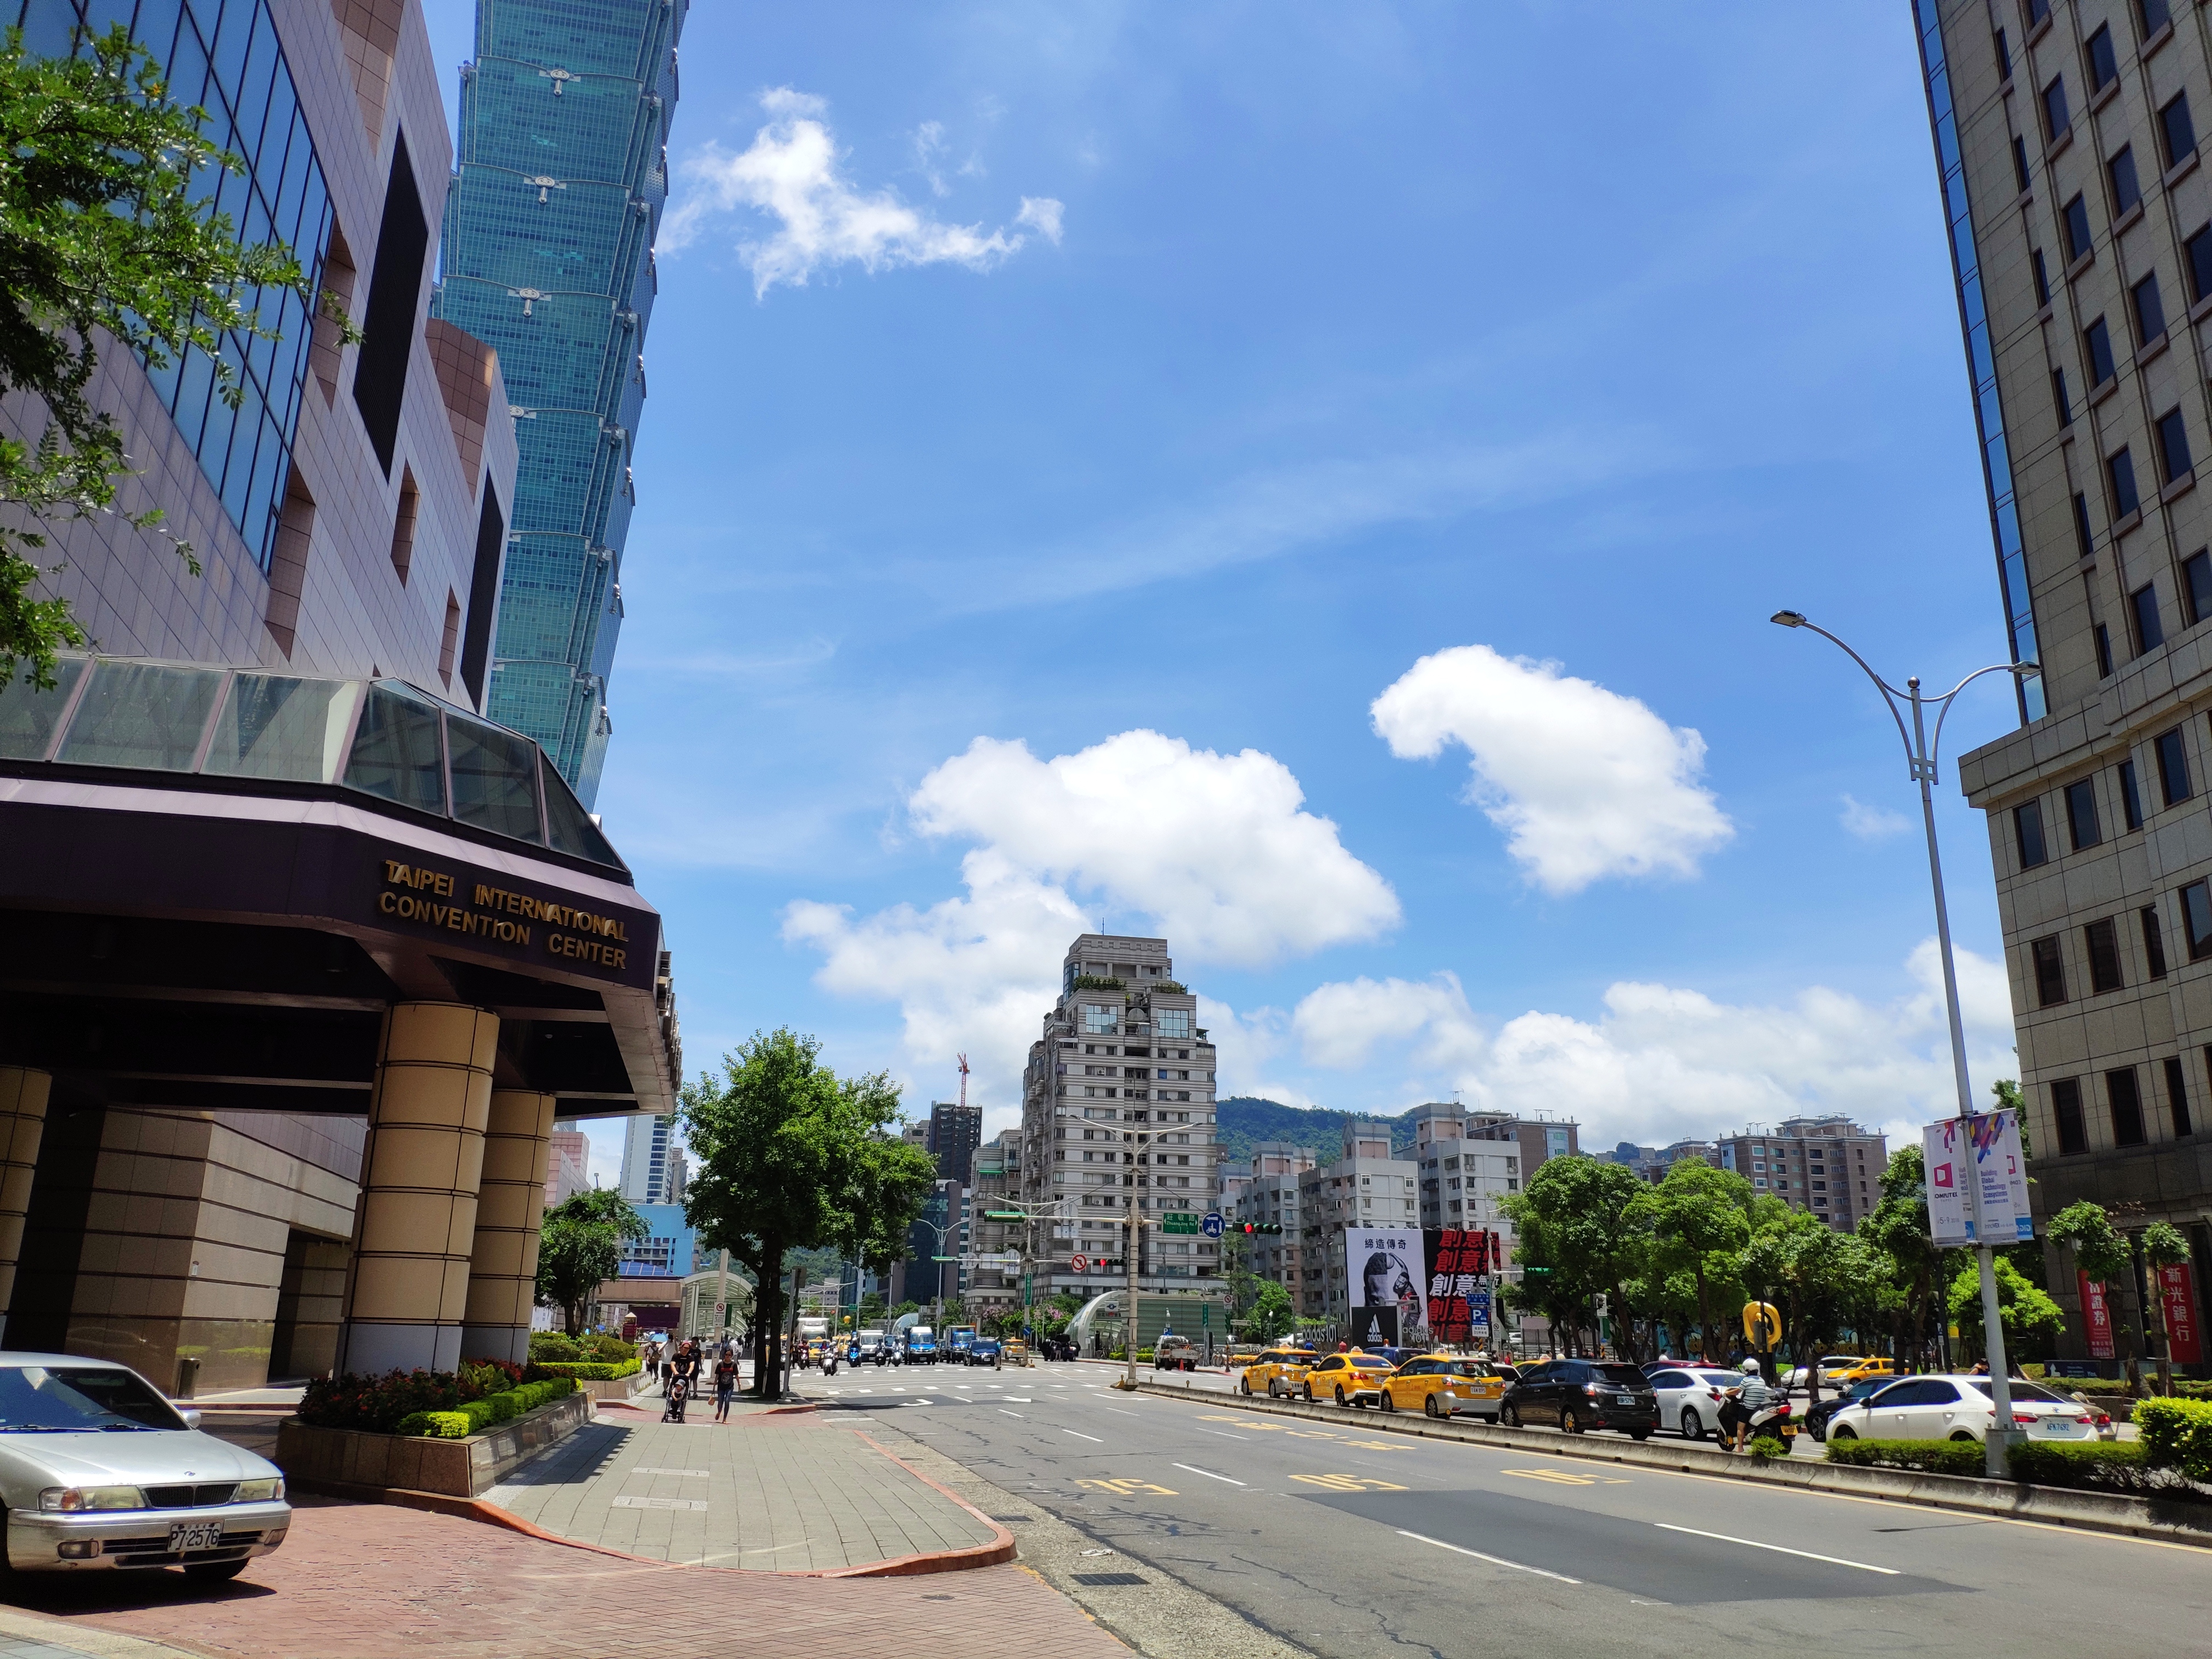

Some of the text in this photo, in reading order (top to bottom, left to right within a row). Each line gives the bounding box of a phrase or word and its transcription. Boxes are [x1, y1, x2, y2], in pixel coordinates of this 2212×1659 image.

[382, 860, 629, 942] TAIPEI INTERNATIONAL
[379, 891, 627, 969] CONVENTION CENTER
[1983, 1190, 2008, 1199] Ecosystems
[1166, 1213, 1195, 1221] 莊敬路
[1364, 1238, 1406, 1249] 締造傳奇
[1434, 1249, 1481, 1272] 創意
[1429, 1273, 1476, 1297] 創意
[1427, 1297, 1471, 1322] 創意
[2165, 1267, 2190, 1342] 新光銀行
[1302, 1325, 1325, 1342] adidas
[1367, 1333, 1383, 1342] adidas
[1402, 1324, 1434, 1334] adidas
